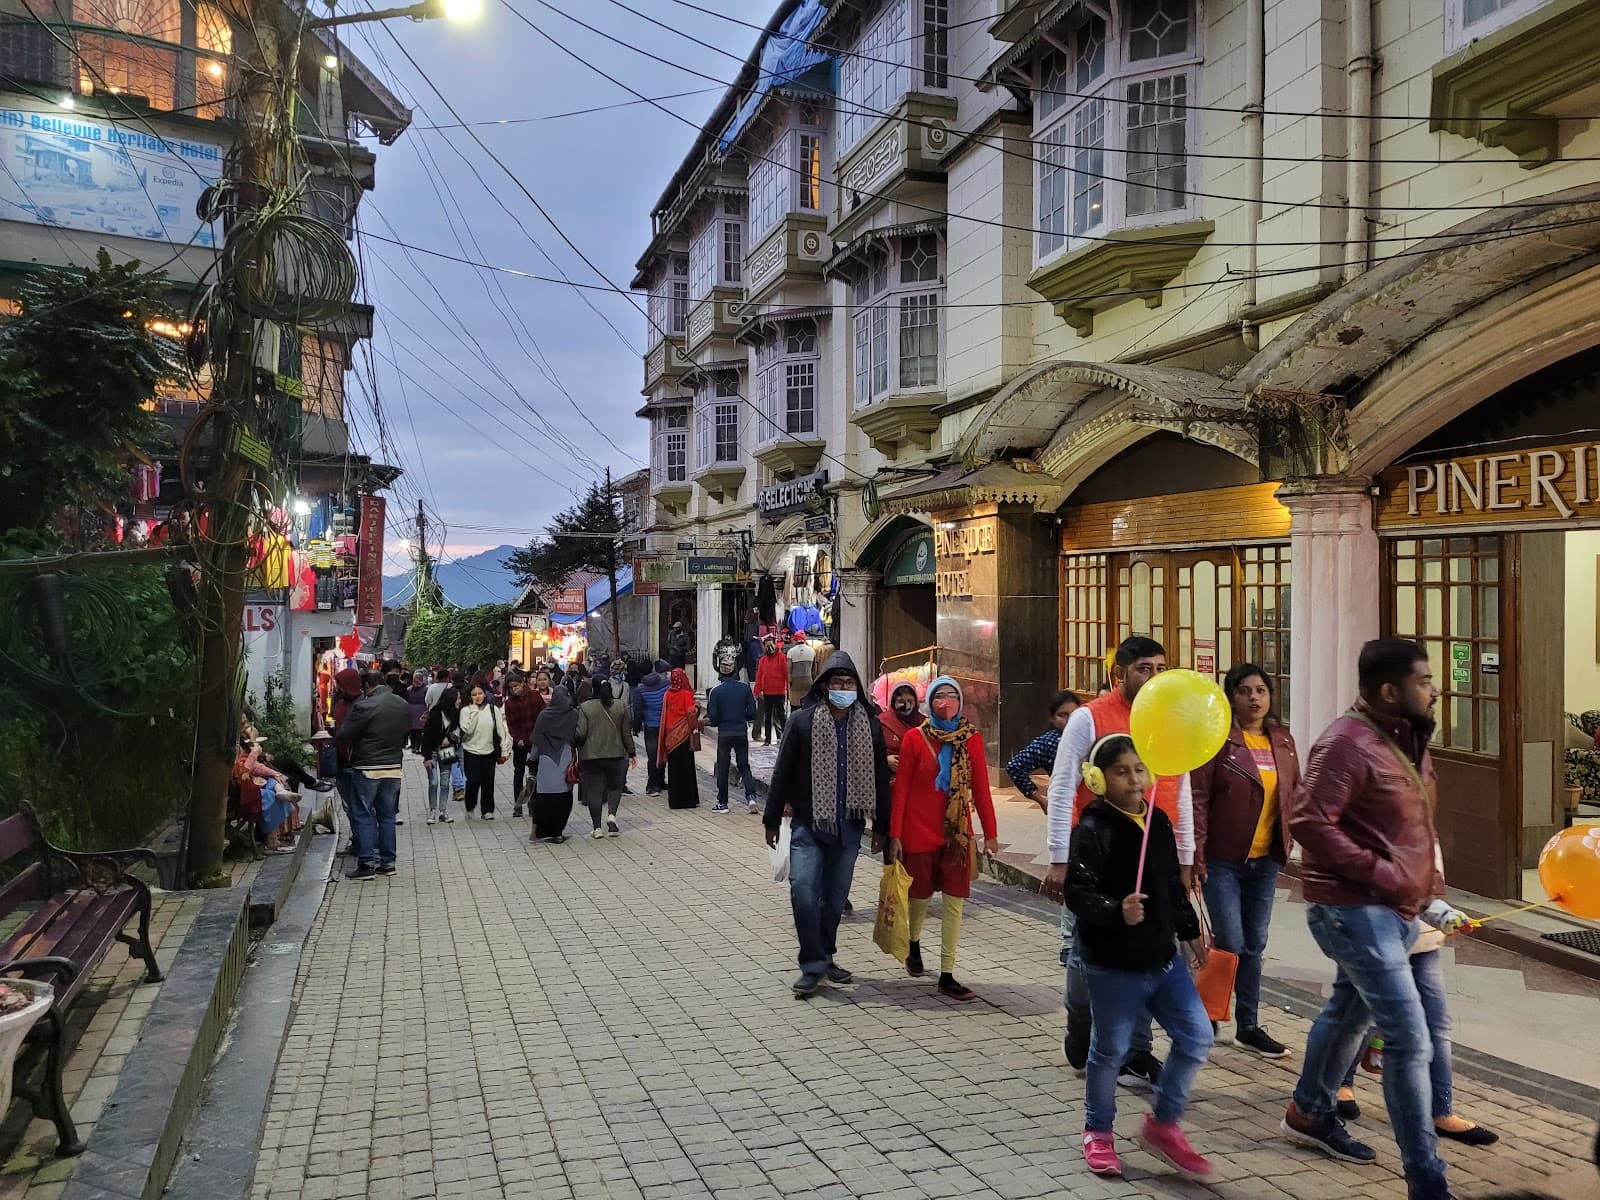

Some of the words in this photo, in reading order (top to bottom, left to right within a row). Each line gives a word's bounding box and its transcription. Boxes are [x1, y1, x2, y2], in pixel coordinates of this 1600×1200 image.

[31, 115, 102, 140] Bellevue
[107, 127, 175, 153] Heritage
[180, 141, 218, 161] Hotel
[153, 175, 184, 187] Expedia
[935, 524, 993, 560] PINERIDGE
[703, 563, 734, 573] Lufthansa
[935, 570, 974, 597] HOTEL
[240, 607, 275, 632] L'S
